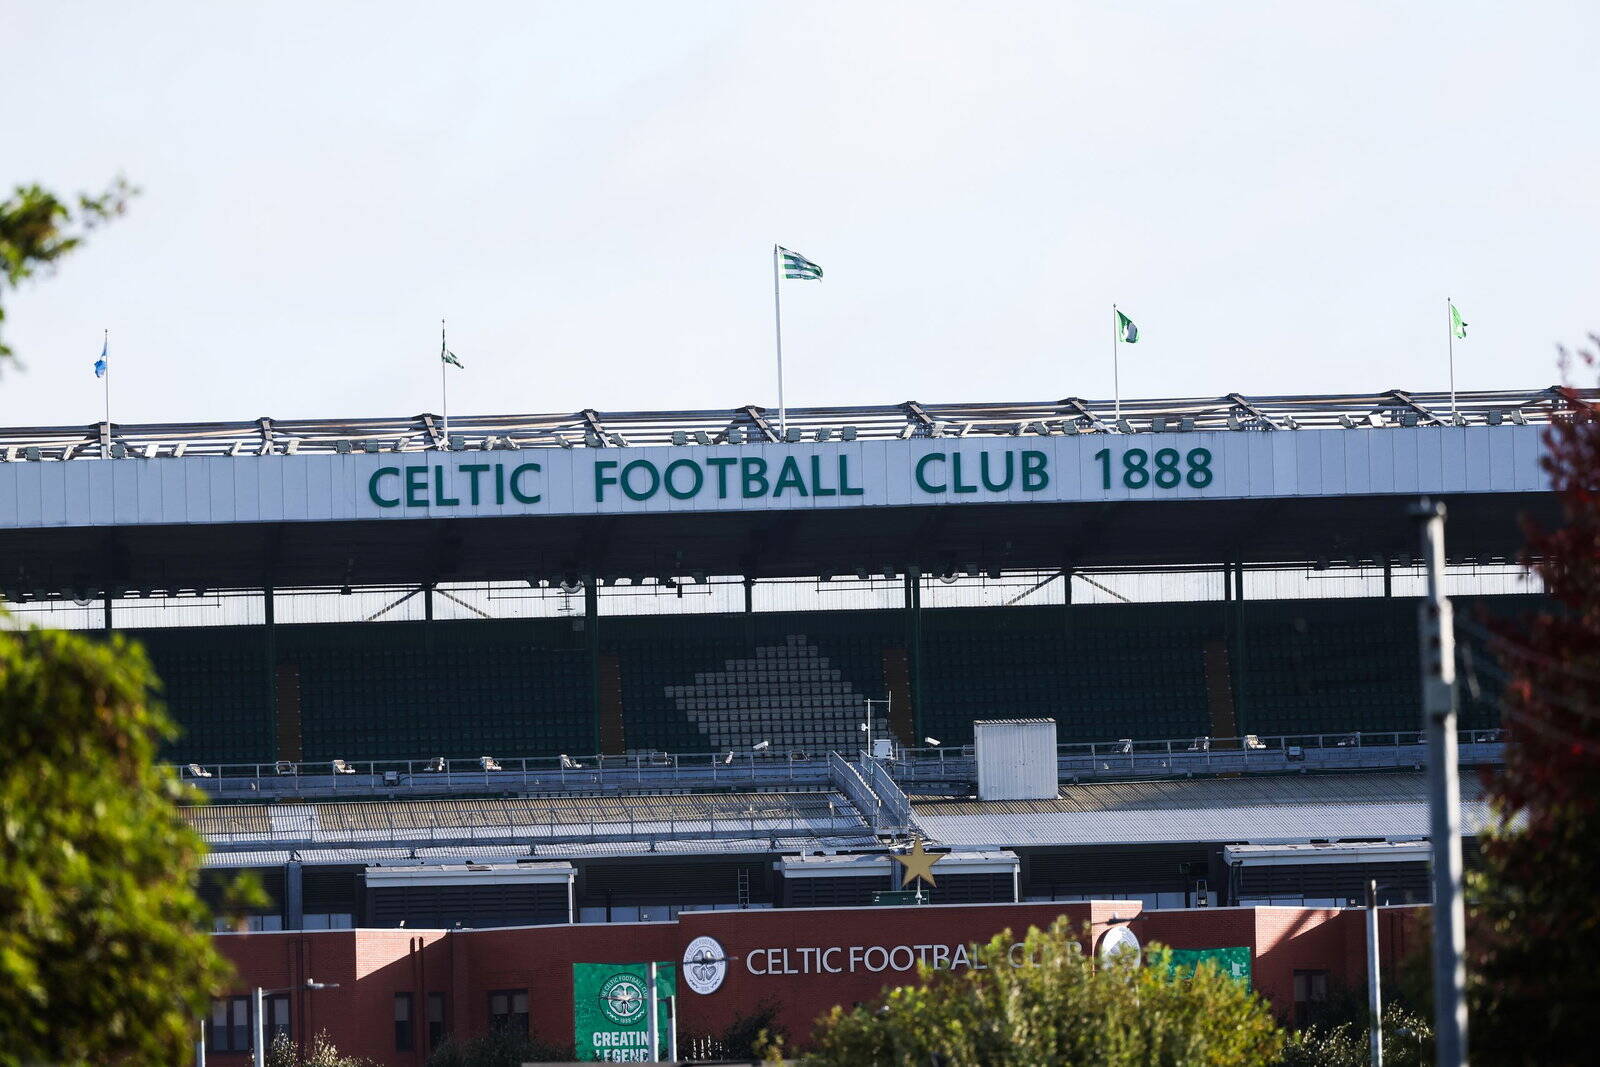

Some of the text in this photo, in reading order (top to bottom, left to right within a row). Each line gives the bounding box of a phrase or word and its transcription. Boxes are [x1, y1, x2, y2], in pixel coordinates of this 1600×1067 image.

[368, 447, 1213, 508] CELTIC FOOTBALL CLUB 1888
[746, 946, 843, 975] CELTIC
[849, 943, 998, 973] FOOTBAL
[592, 1031, 657, 1047] CREATIN
